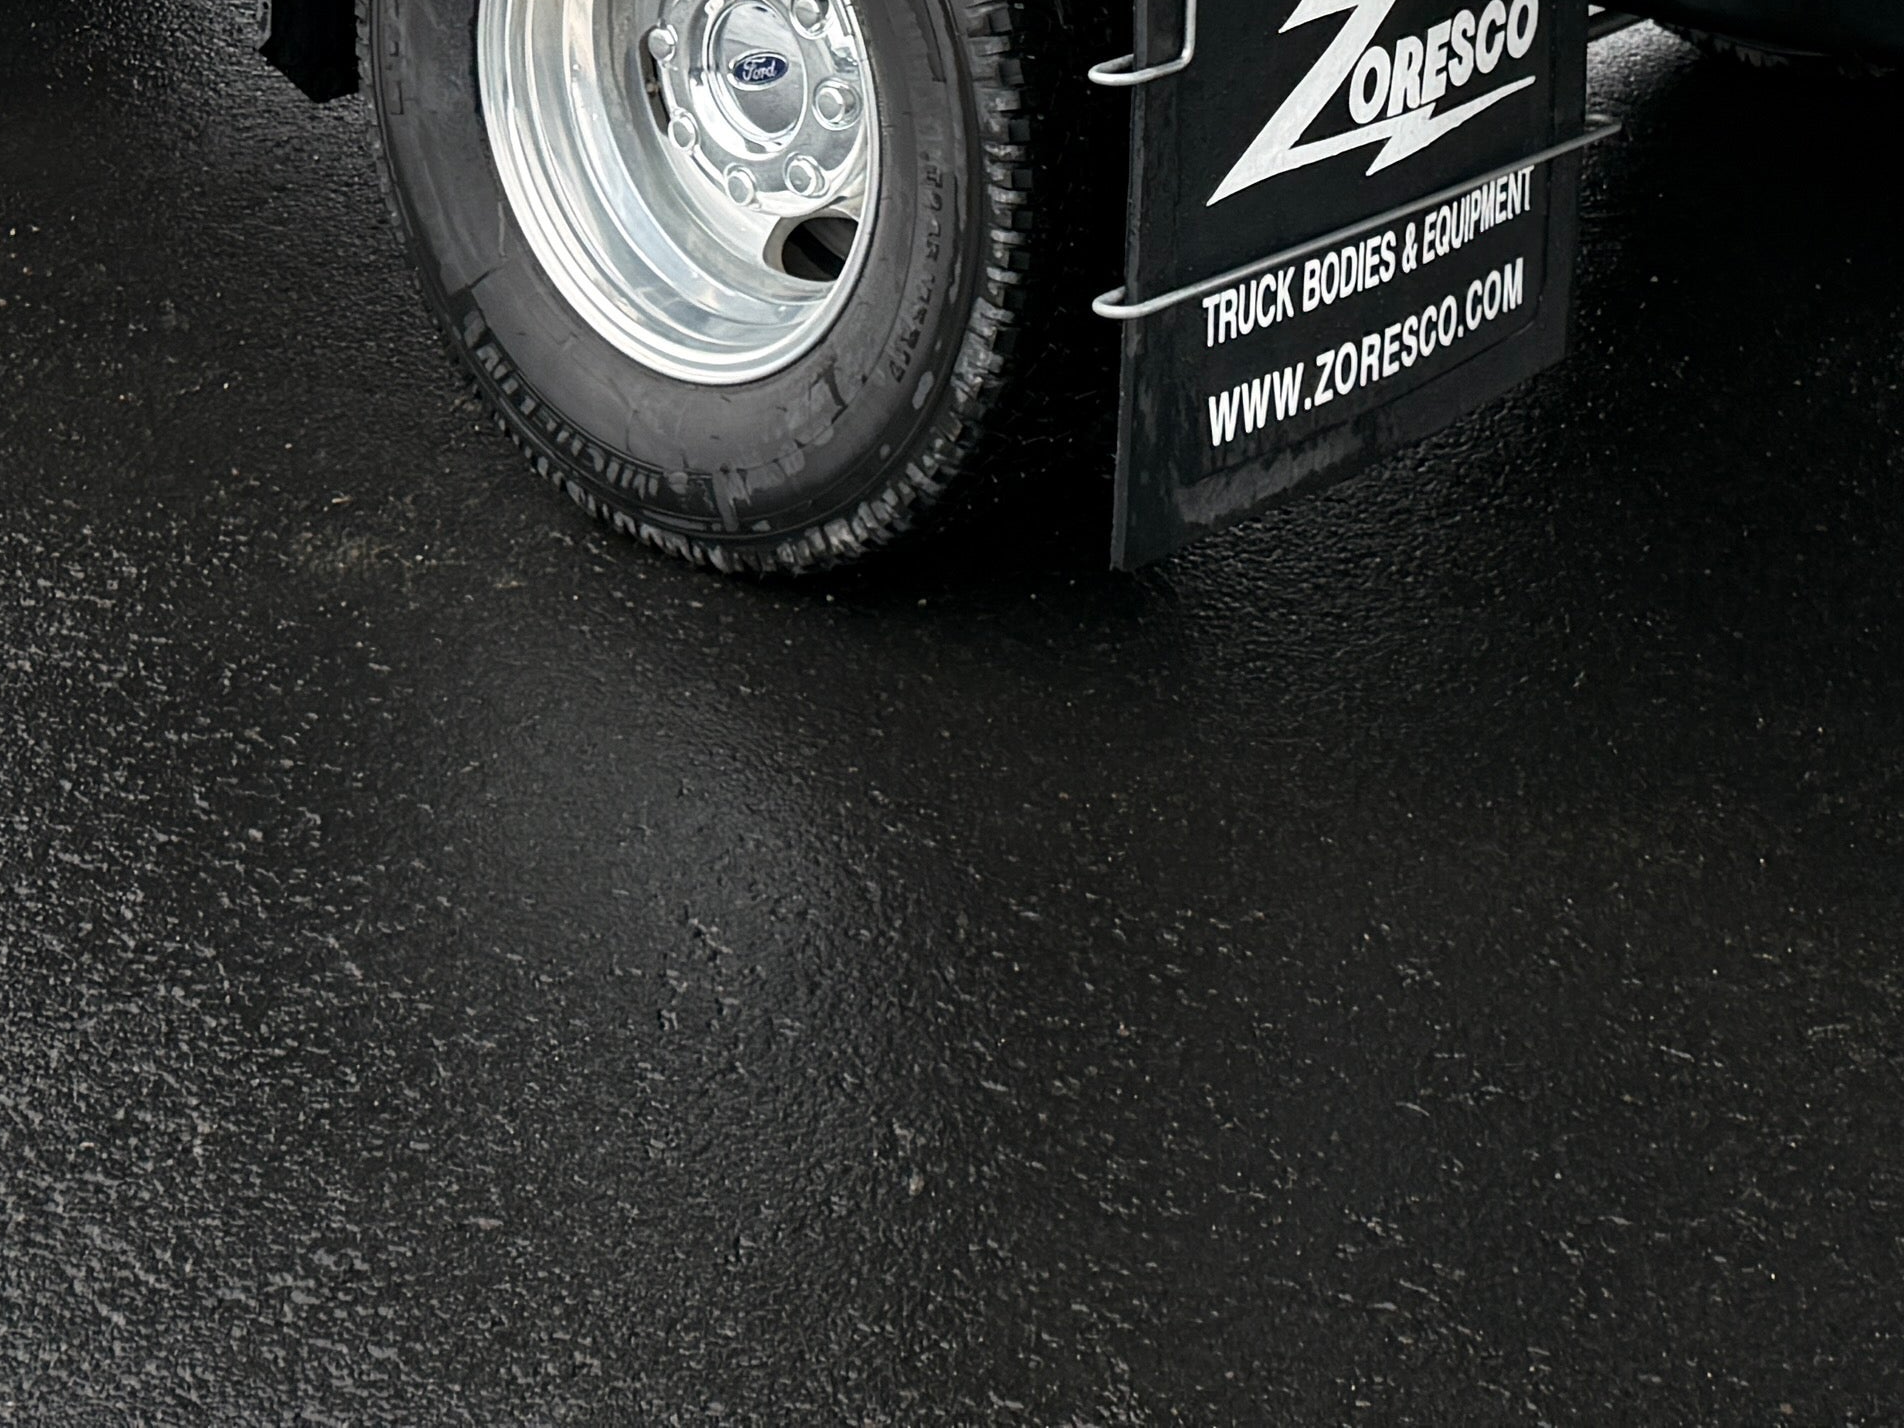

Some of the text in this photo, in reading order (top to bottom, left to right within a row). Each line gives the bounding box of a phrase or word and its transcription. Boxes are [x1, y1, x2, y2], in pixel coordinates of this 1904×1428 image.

[1202, 165, 1535, 348] TRUCK BODIES & EQUIPMENT
[1208, 256, 1524, 447] WWW.ZORESCO.COM
